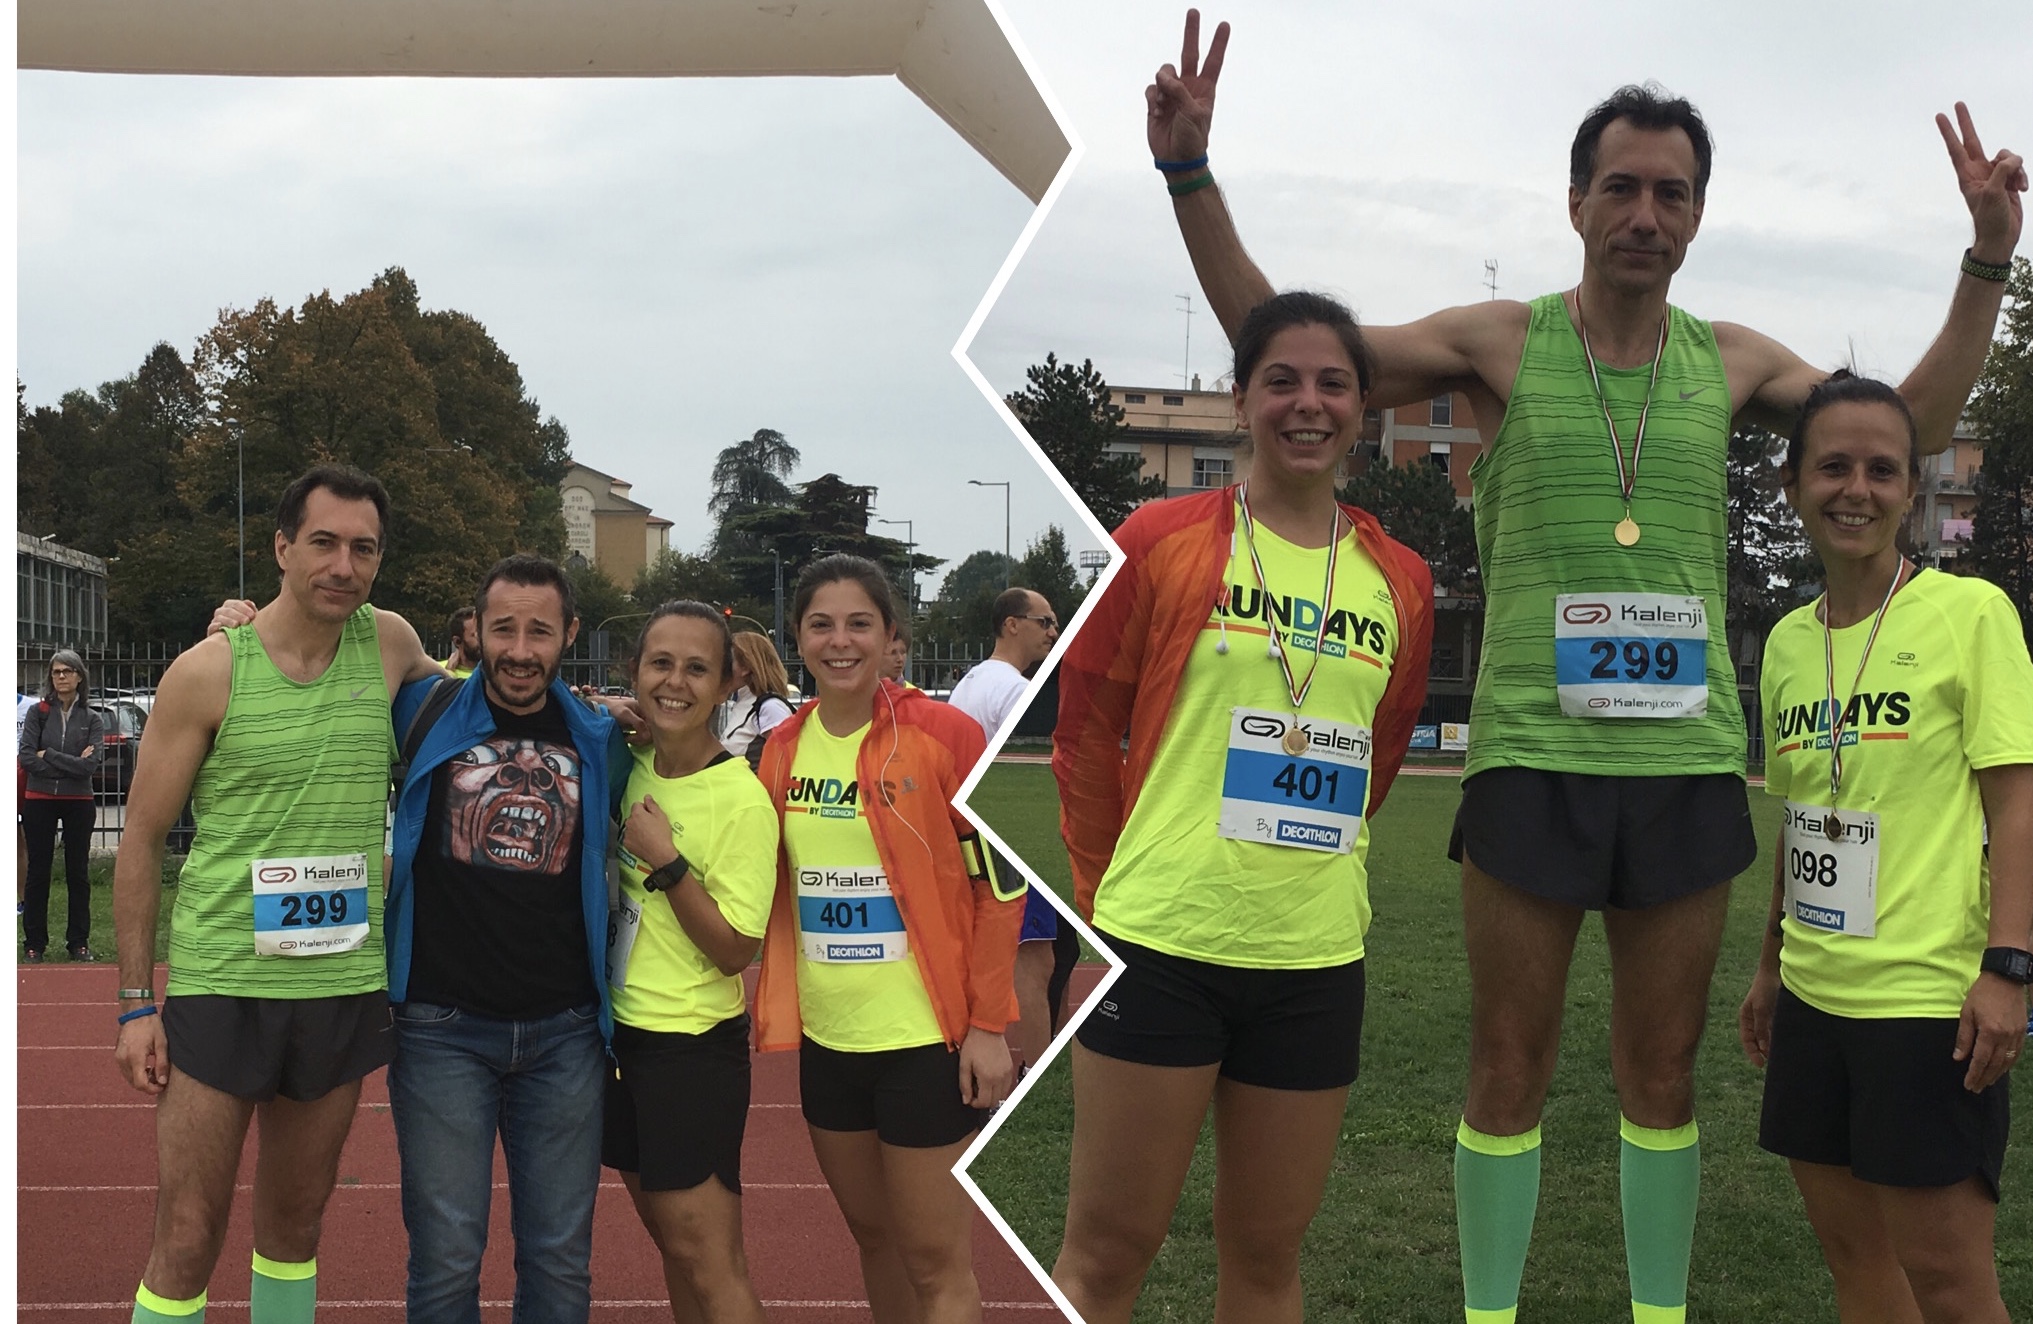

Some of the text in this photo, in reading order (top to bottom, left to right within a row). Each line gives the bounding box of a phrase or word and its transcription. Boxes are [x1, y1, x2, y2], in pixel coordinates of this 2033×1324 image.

[1620, 604, 1703, 629] Kalenji
[1293, 636, 1344, 656] DECAHLON
[1589, 640, 1679, 681] 299
[1613, 697, 1683, 711] Kalenji.com
[1775, 691, 1911, 746] RUNDAYS
[1802, 738, 1815, 750] BY
[1273, 762, 1339, 804] 401
[809, 806, 820, 815] BY
[1256, 817, 1339, 845] By DECATHLON
[1794, 809, 1875, 845] Kalnji
[303, 863, 365, 881] Kalenji
[1790, 846, 1838, 888] 098
[280, 892, 348, 927] 299
[820, 901, 868, 929] 401
[1797, 904, 1842, 927] DECATHLON
[299, 936, 352, 949] Kalenji.com
[829, 946, 881, 958] DECATHLON
